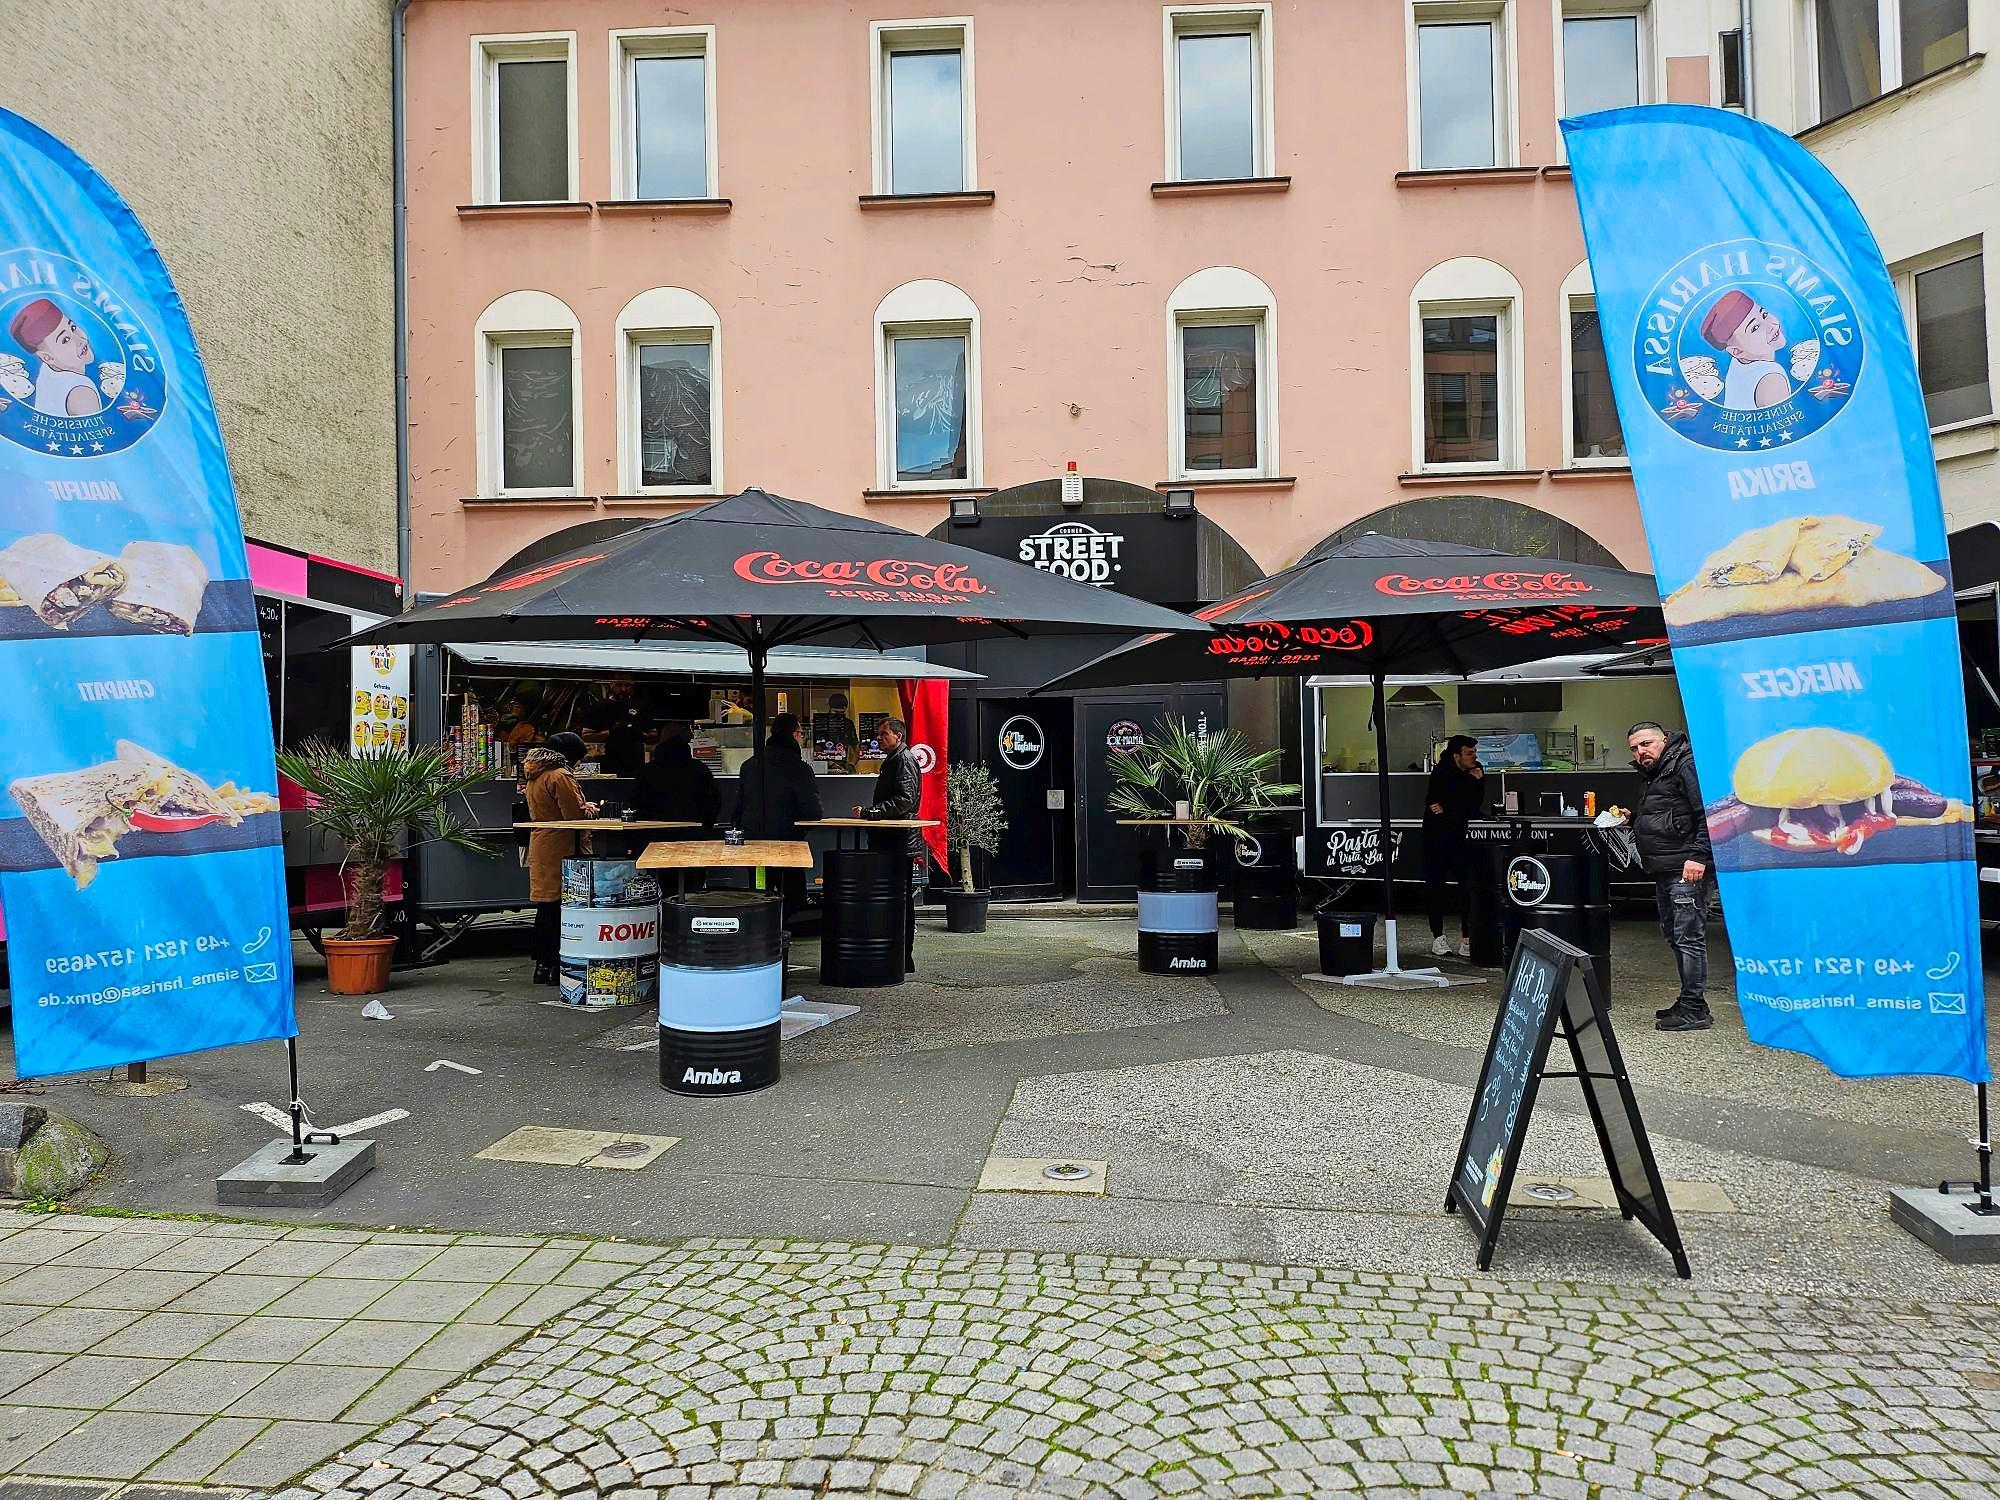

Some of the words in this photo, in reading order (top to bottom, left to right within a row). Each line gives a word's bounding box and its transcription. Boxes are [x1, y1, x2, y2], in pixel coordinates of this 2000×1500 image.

[1019, 536, 1124, 561] STREET
[733, 551, 988, 595] Coca-Cola
[1034, 559, 1110, 582] FOOD
[1374, 572, 1593, 596] Coca-Cola
[825, 590, 890, 599] ZERO
[896, 591, 971, 603] SUGAR
[1012, 731, 1025, 742] The
[1326, 828, 1380, 857] Pasta
[1326, 855, 1336, 866] la
[598, 921, 656, 942] ROWE
[1169, 957, 1207, 969] Ambra
[1515, 955, 1536, 996] Hot
[1532, 967, 1549, 1028] Dog
[682, 1067, 741, 1085] Ambra
